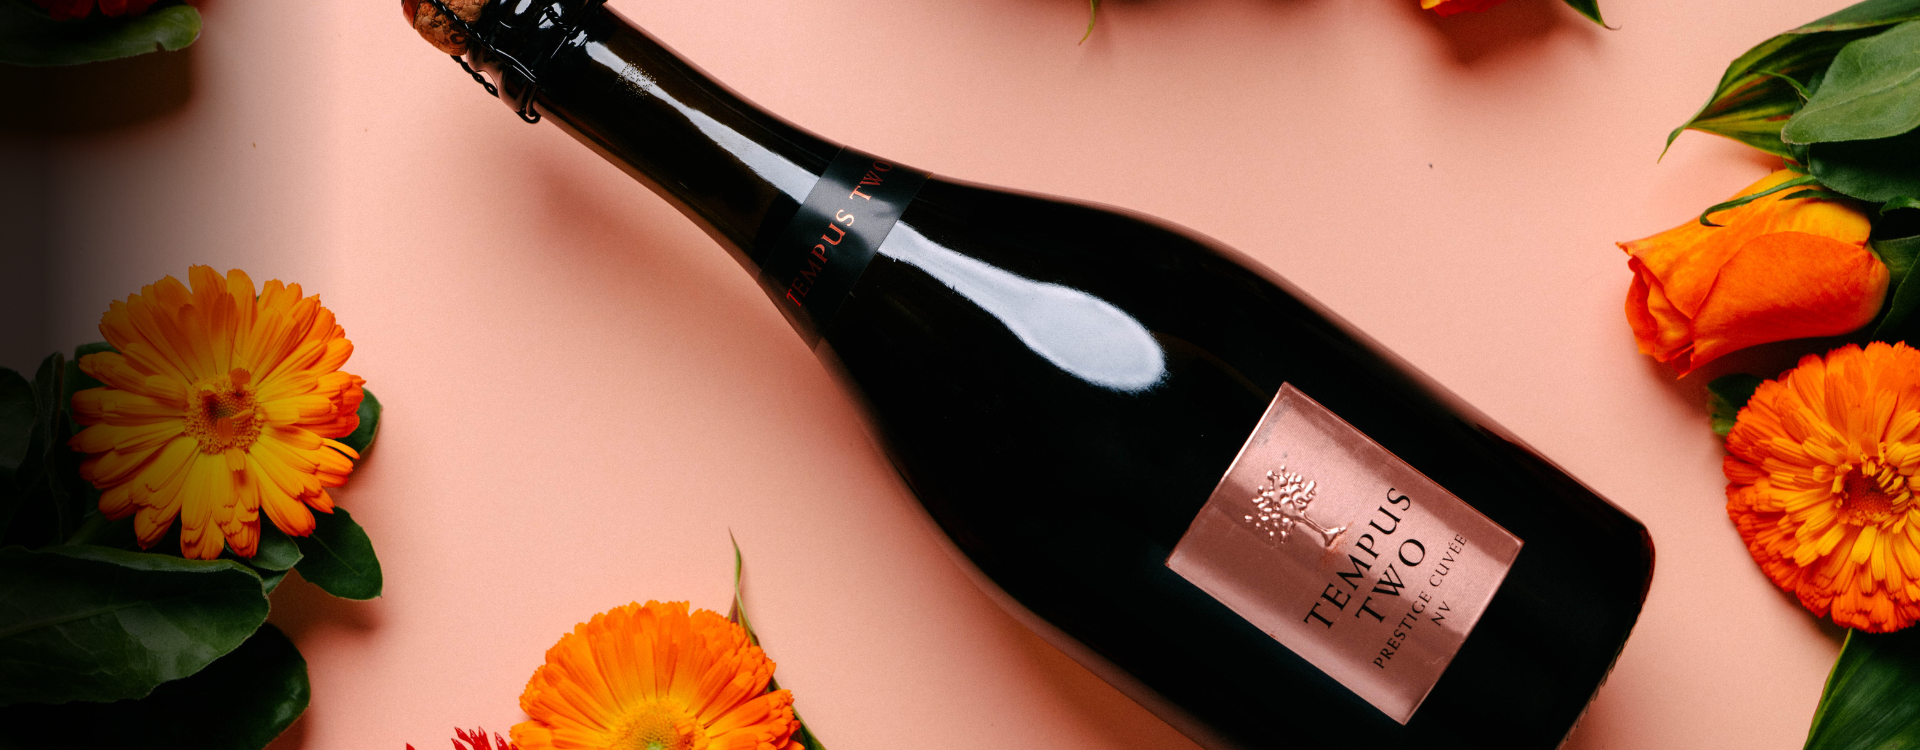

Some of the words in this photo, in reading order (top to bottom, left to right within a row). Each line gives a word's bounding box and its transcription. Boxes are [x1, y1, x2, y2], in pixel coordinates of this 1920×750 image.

[786, 209, 855, 307] TEMPUS
[849, 160, 893, 201] TWO
[1303, 487, 1411, 630] TEMPUS
[1355, 538, 1426, 624] TWO
[1373, 591, 1432, 669] PRESTIGE
[1429, 534, 1467, 587] CUVÉE
[1430, 601, 1451, 627] NV
